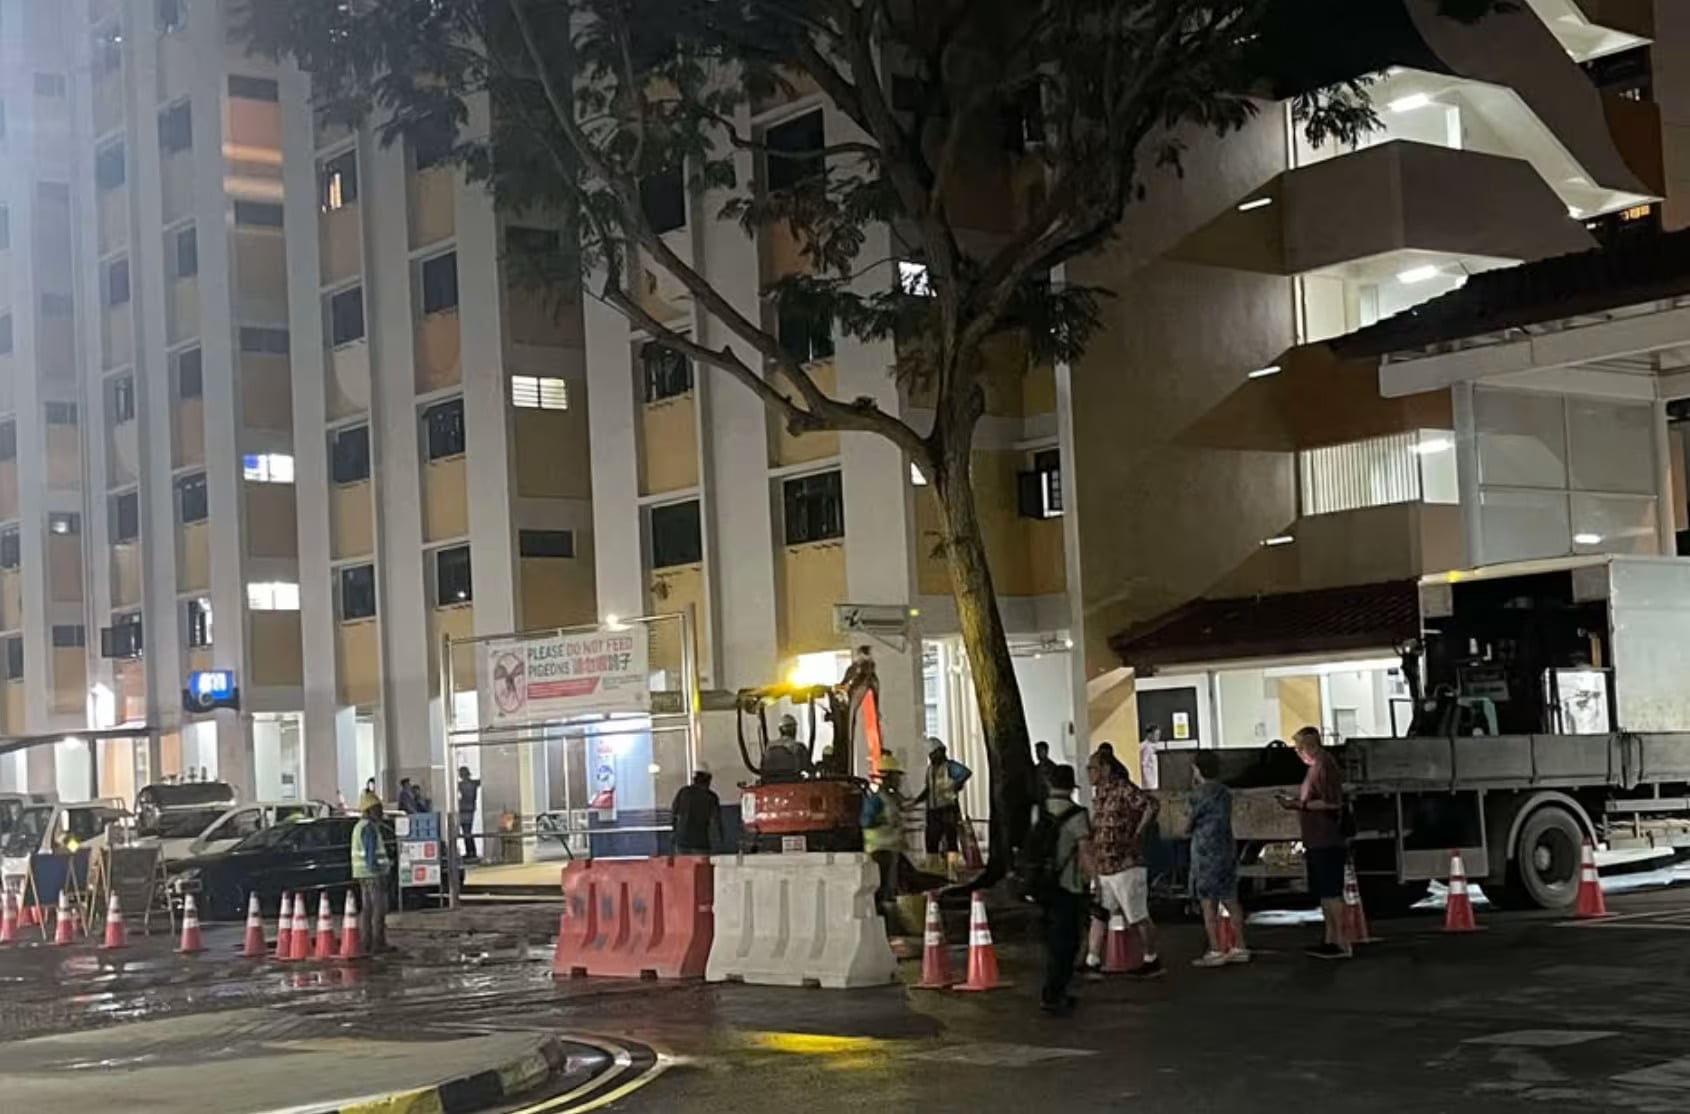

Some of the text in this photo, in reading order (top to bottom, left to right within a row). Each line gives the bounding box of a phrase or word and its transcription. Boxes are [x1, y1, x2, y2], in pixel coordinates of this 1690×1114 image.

[528, 637, 632, 660] PLEASE DO NOT FEED
[528, 661, 569, 676] PIGEONS
